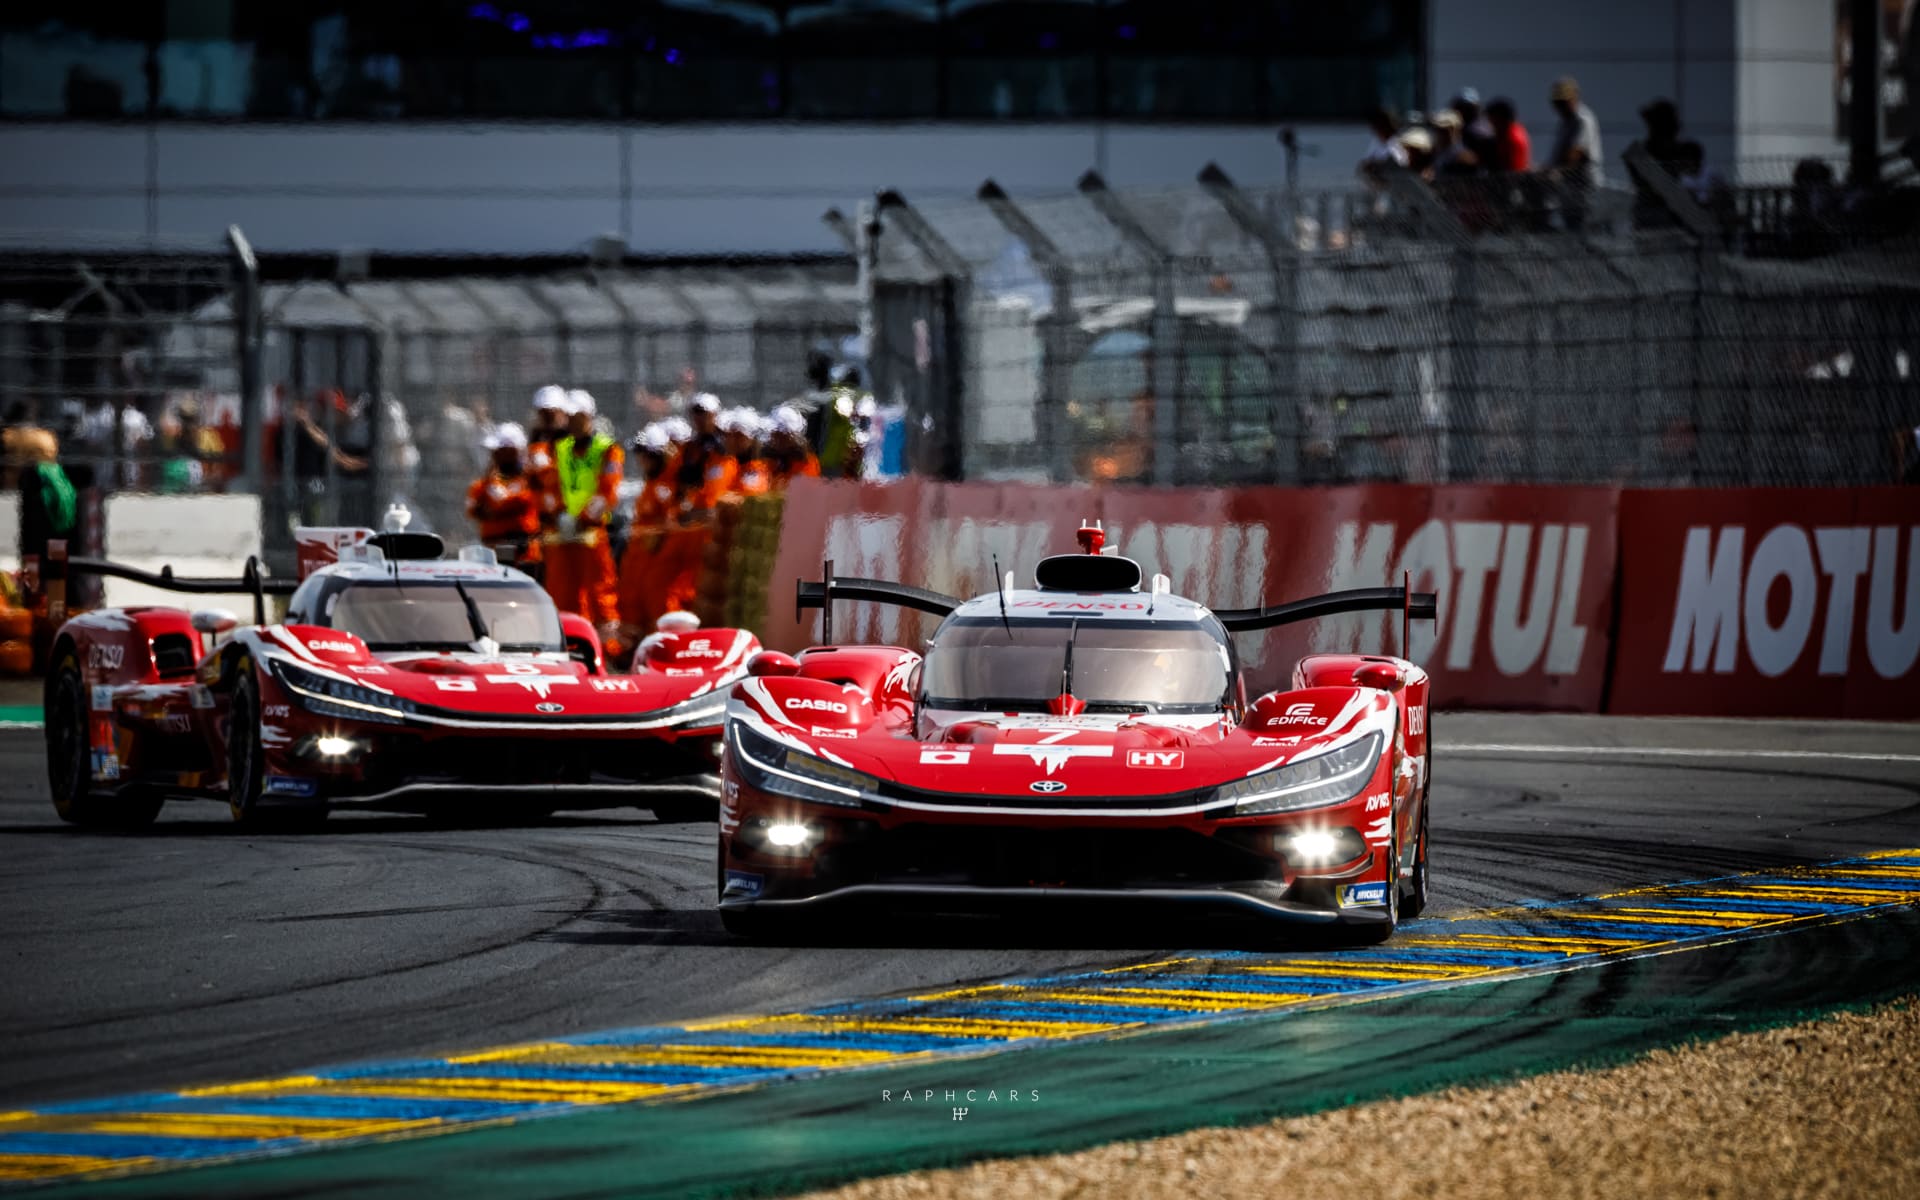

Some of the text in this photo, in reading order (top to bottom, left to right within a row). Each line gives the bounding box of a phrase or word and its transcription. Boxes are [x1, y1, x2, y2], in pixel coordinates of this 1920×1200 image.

[1309, 519, 1589, 676] MOTUL
[1013, 600, 1144, 611] DENSO
[308, 640, 356, 653] CASIO
[593, 680, 630, 691] HY
[785, 698, 847, 714] CASIO
[1267, 716, 1328, 726] EDIFICE
[1036, 728, 1080, 744] 7
[1131, 752, 1179, 766] HY
